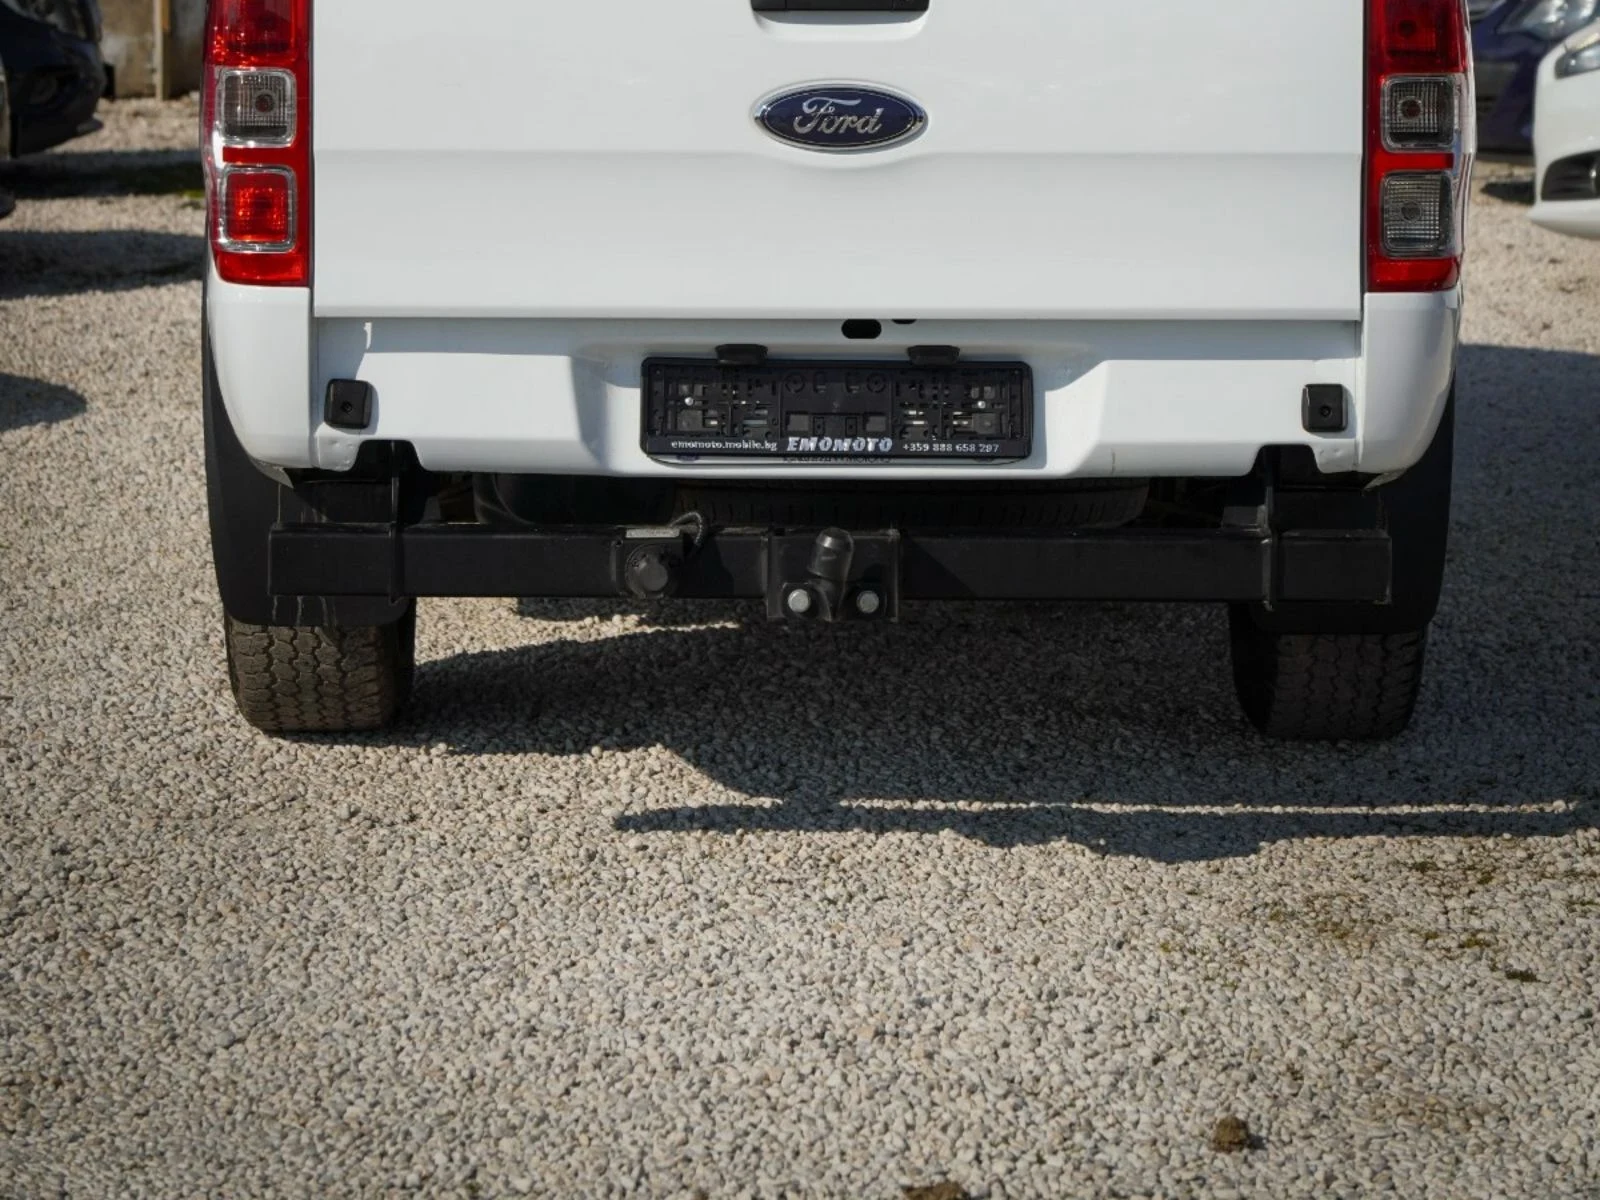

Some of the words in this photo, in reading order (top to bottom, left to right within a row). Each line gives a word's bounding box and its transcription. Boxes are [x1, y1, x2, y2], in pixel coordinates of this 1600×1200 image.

[793, 97, 884, 134] Ford
[671, 440, 777, 452] emomoto.mobile.bg
[787, 436, 893, 452] EMOMOTO
[902, 443, 930, 453] +359
[932, 443, 953, 453] 888
[955, 443, 976, 453] 658
